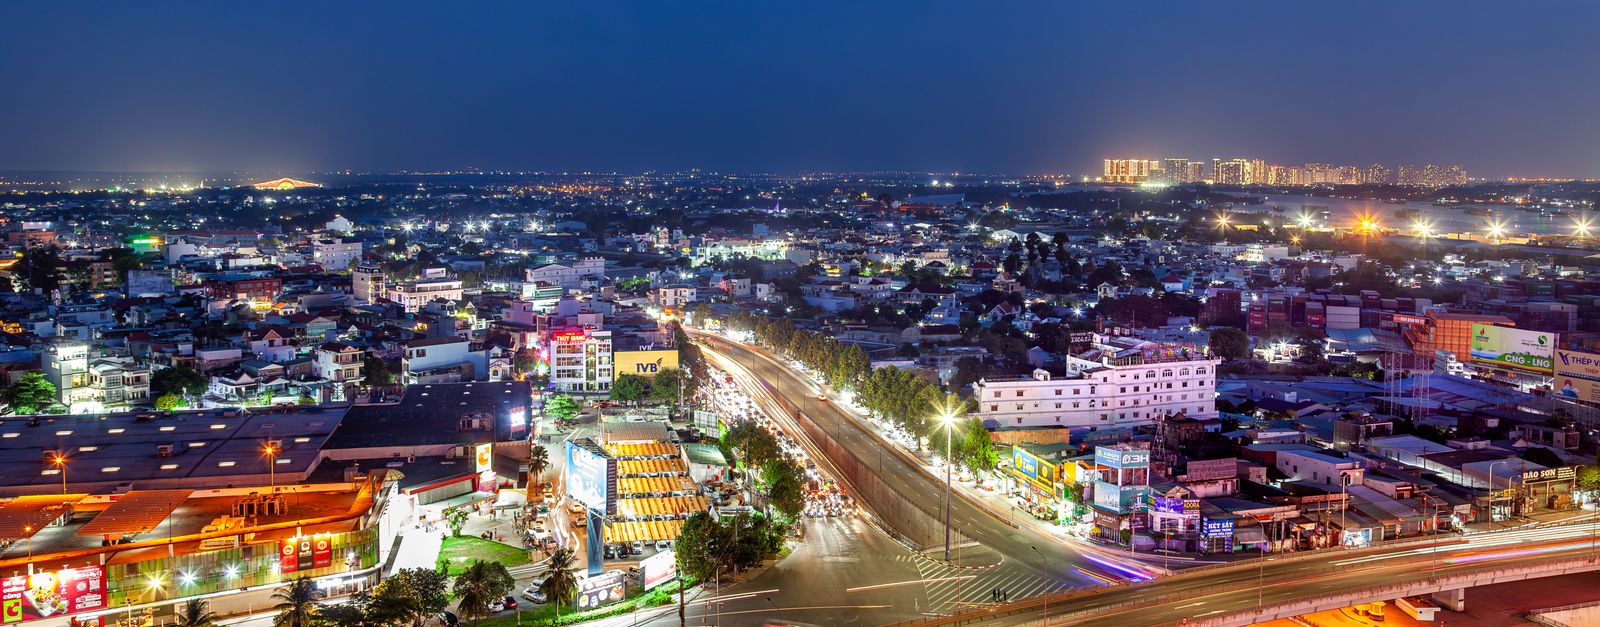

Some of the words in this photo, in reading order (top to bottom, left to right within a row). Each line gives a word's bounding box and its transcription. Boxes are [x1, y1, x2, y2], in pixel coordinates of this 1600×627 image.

[1505, 354, 1525, 364] CNG
[1532, 360, 1551, 368] LNG
[1571, 356, 1592, 365] THÉP
[636, 363, 657, 372] IVB
